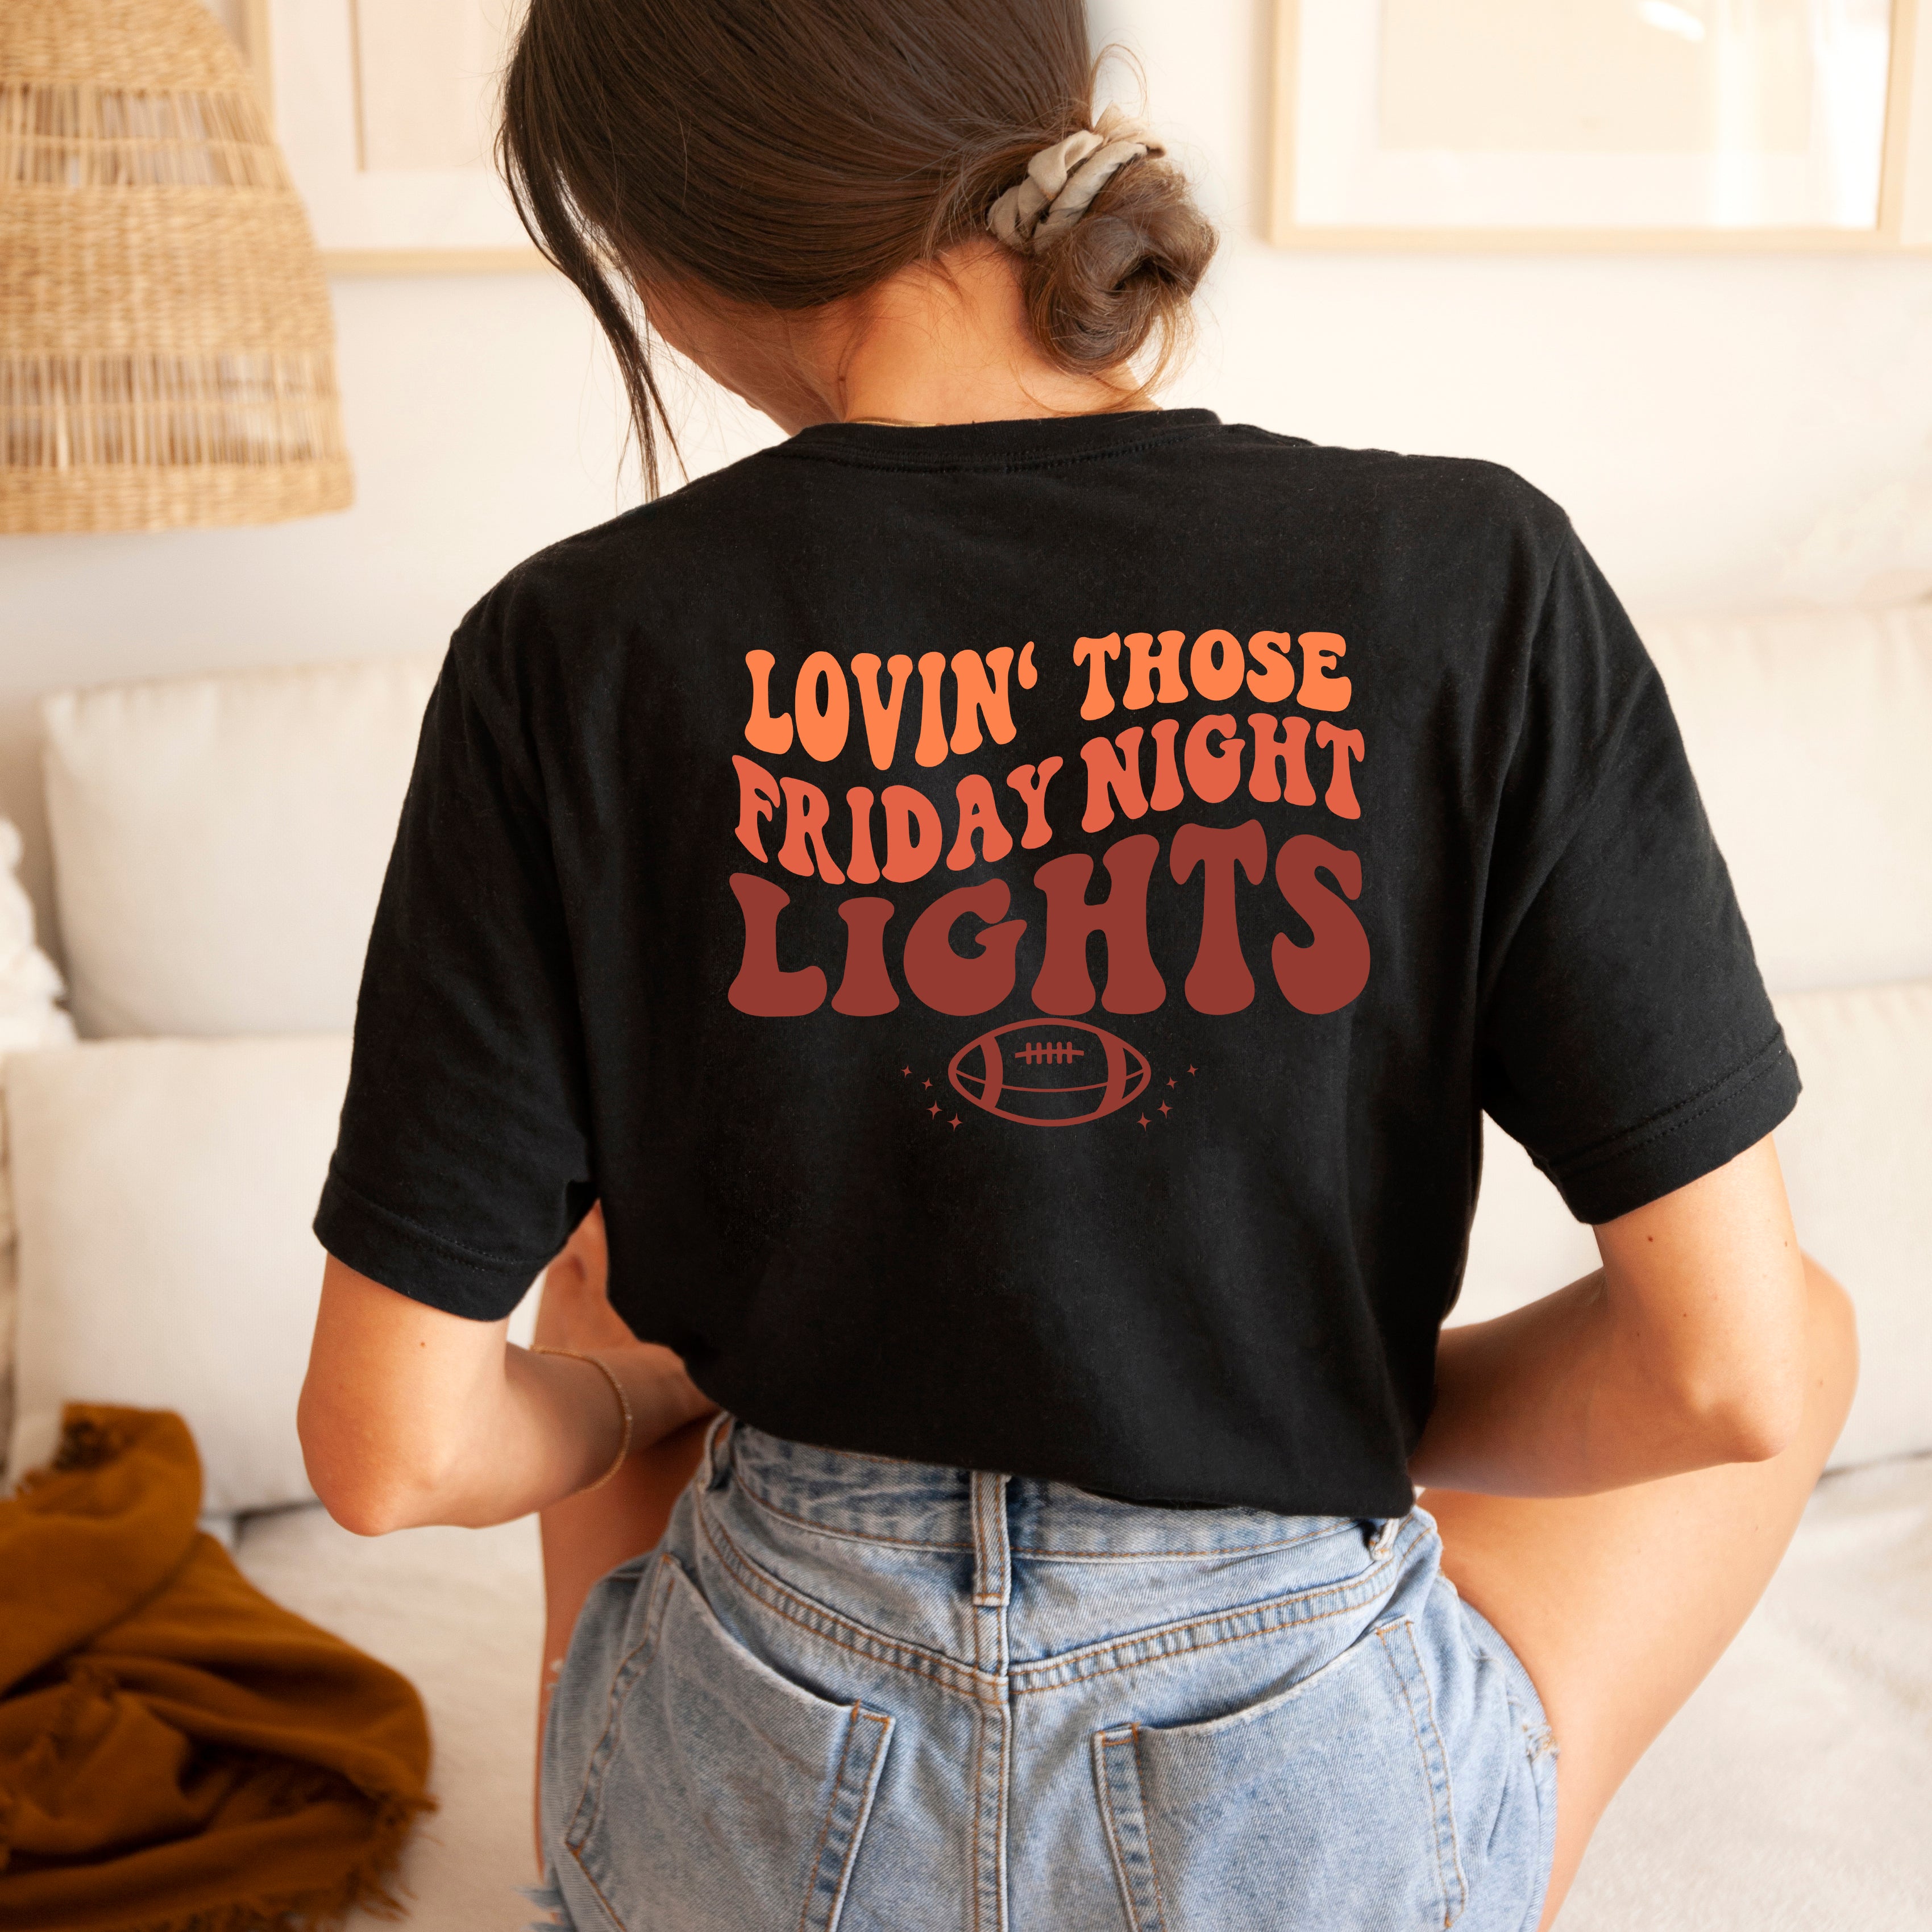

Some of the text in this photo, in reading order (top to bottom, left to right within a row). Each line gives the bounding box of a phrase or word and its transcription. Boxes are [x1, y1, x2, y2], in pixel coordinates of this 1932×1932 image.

[1073, 628, 1352, 721] THOSE
[731, 712, 1365, 885] FRIDAY NIGHT
[727, 819, 1370, 1017] LIGHTS
